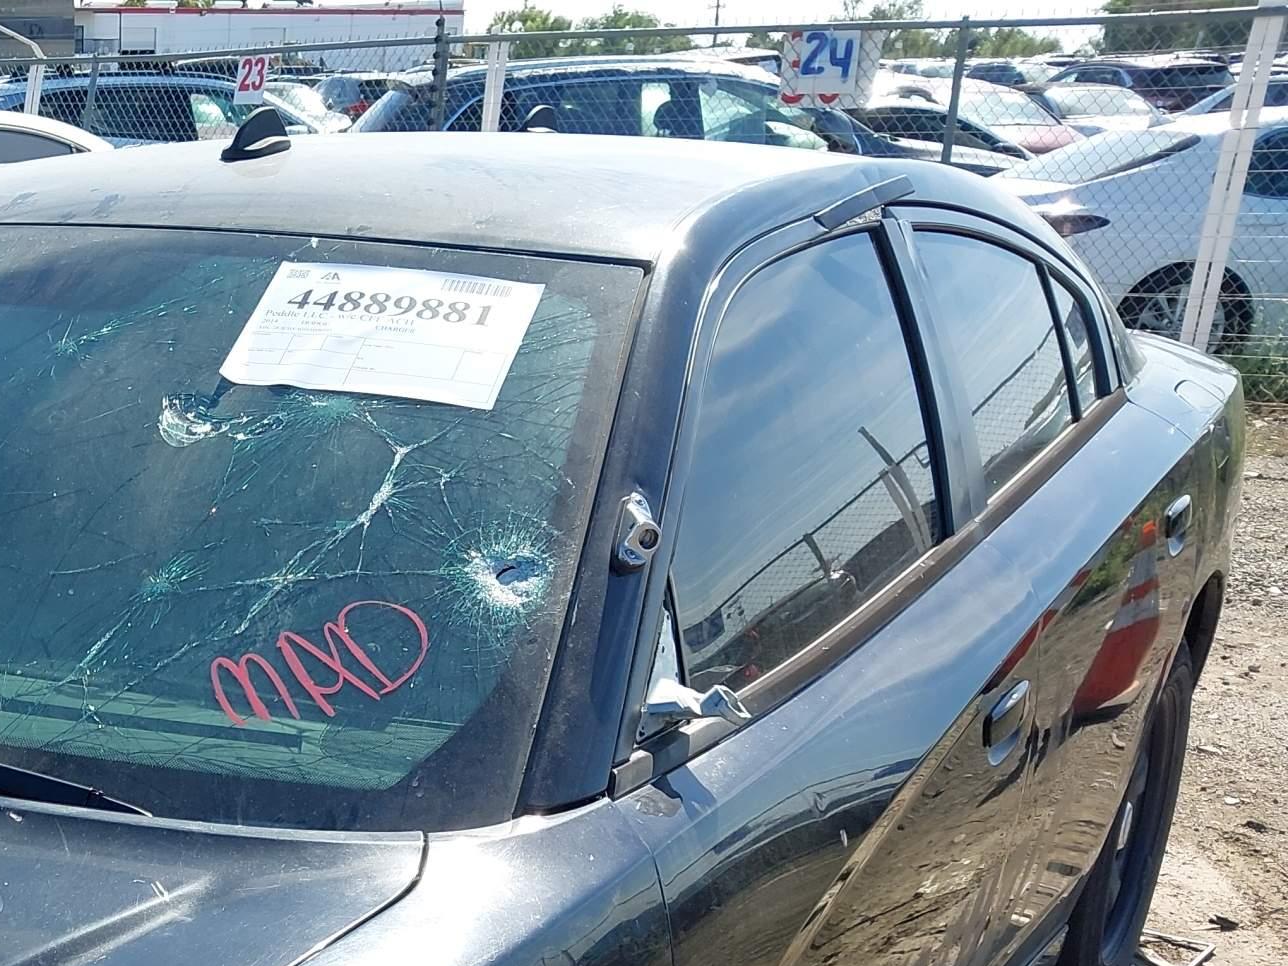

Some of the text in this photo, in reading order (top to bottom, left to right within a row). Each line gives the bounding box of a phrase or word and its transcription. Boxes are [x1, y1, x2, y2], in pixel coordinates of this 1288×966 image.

[238, 56, 266, 92] 23
[800, 31, 854, 84] 24
[287, 288, 492, 327] 44889881
